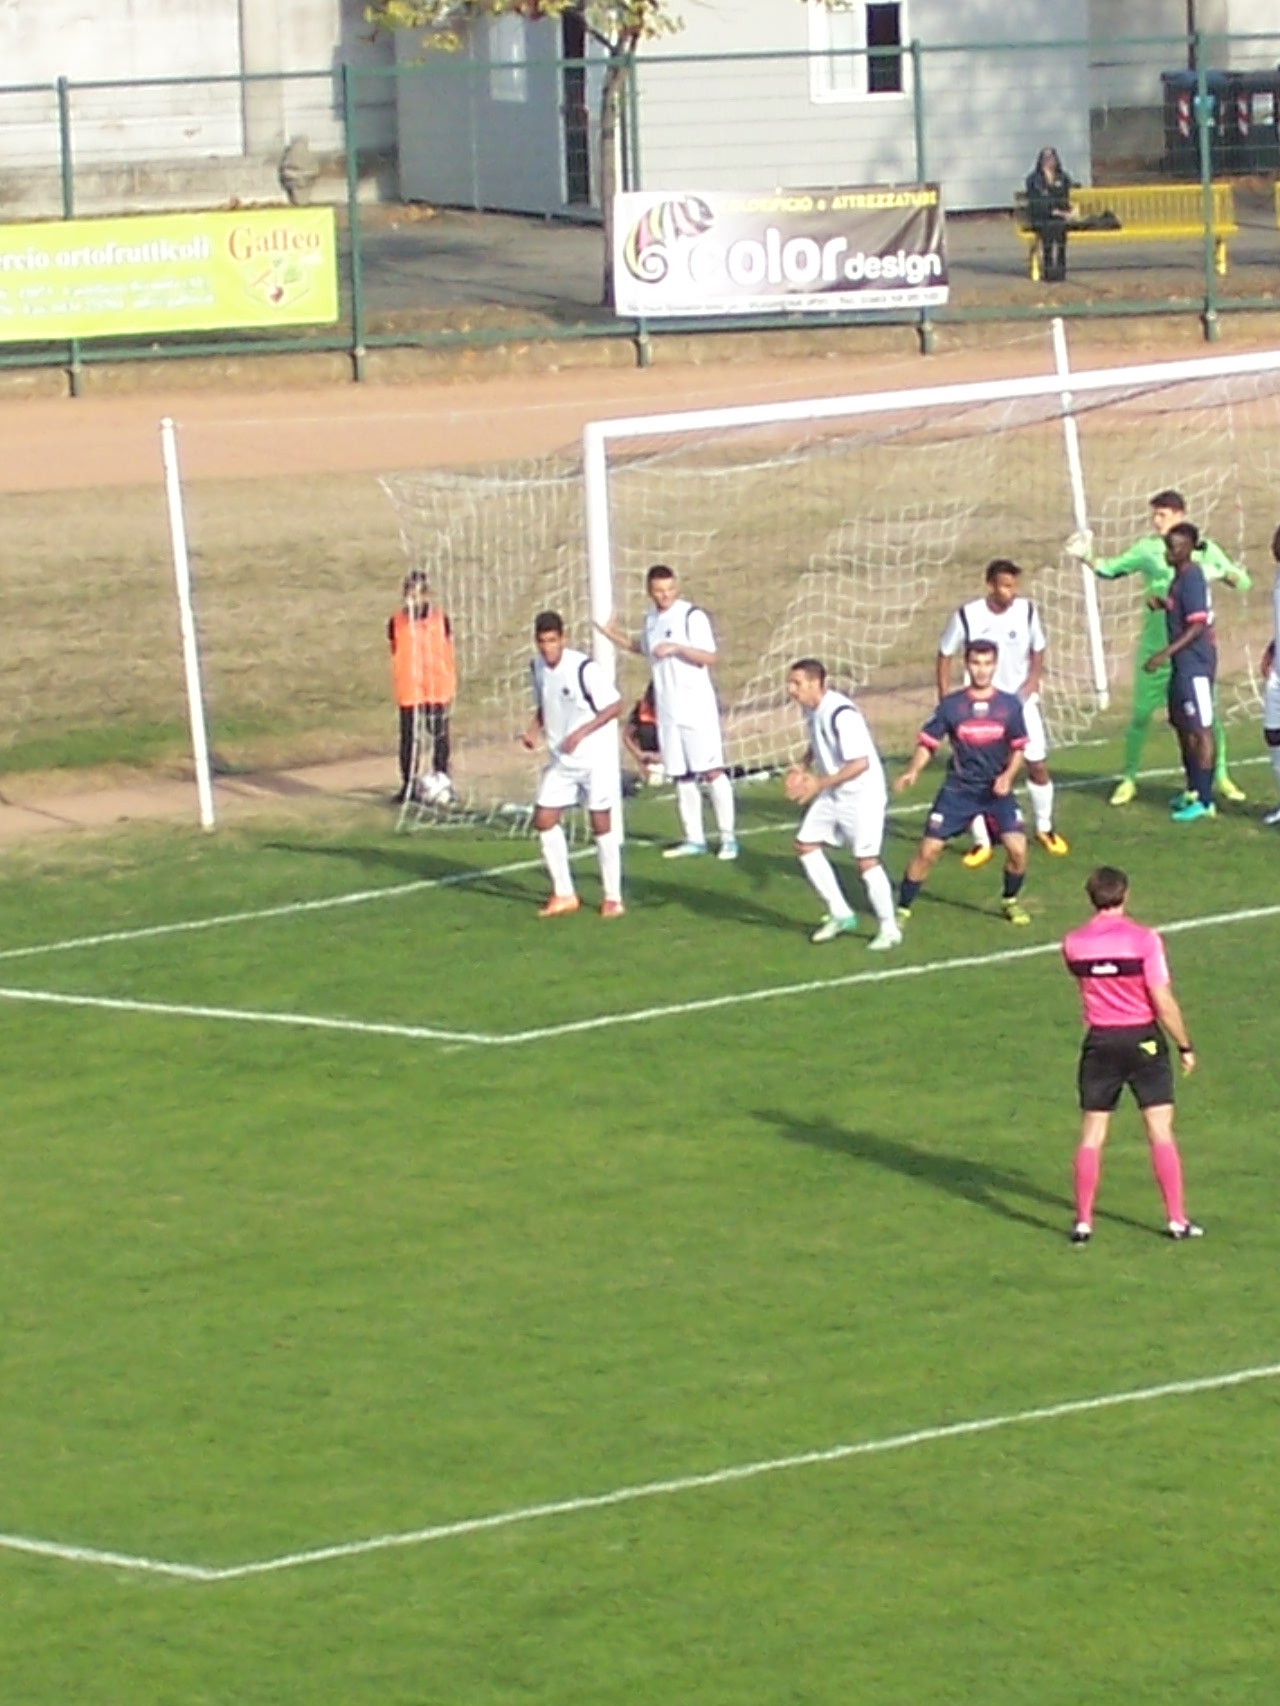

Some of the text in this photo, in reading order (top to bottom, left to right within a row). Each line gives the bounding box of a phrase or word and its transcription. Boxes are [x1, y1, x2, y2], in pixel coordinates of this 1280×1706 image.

[0, 235, 210, 270] rcio ortofrutticoli
[844, 250, 941, 284] design
